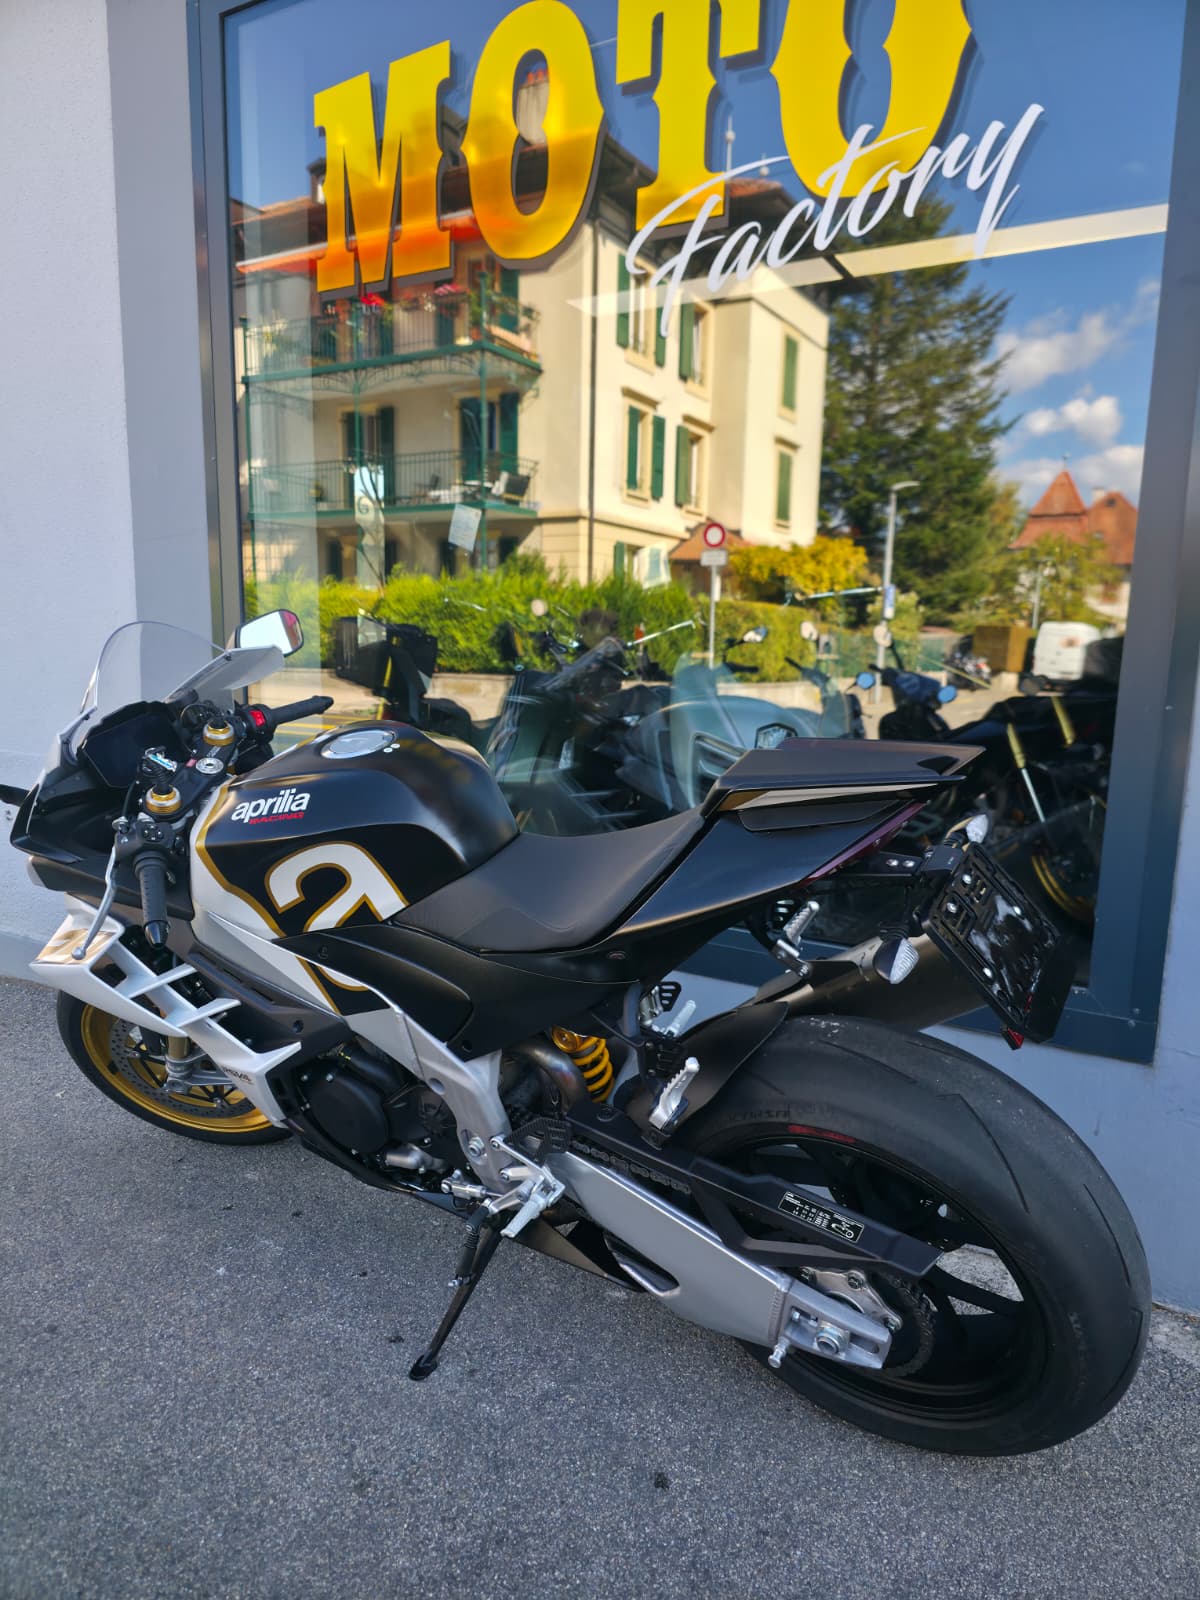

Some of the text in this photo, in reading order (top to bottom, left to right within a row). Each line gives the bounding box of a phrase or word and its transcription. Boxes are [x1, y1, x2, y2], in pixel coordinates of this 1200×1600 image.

[313, 0, 972, 293] MOTO
[625, 103, 1044, 338] Factory
[231, 788, 311, 823] aprilia
